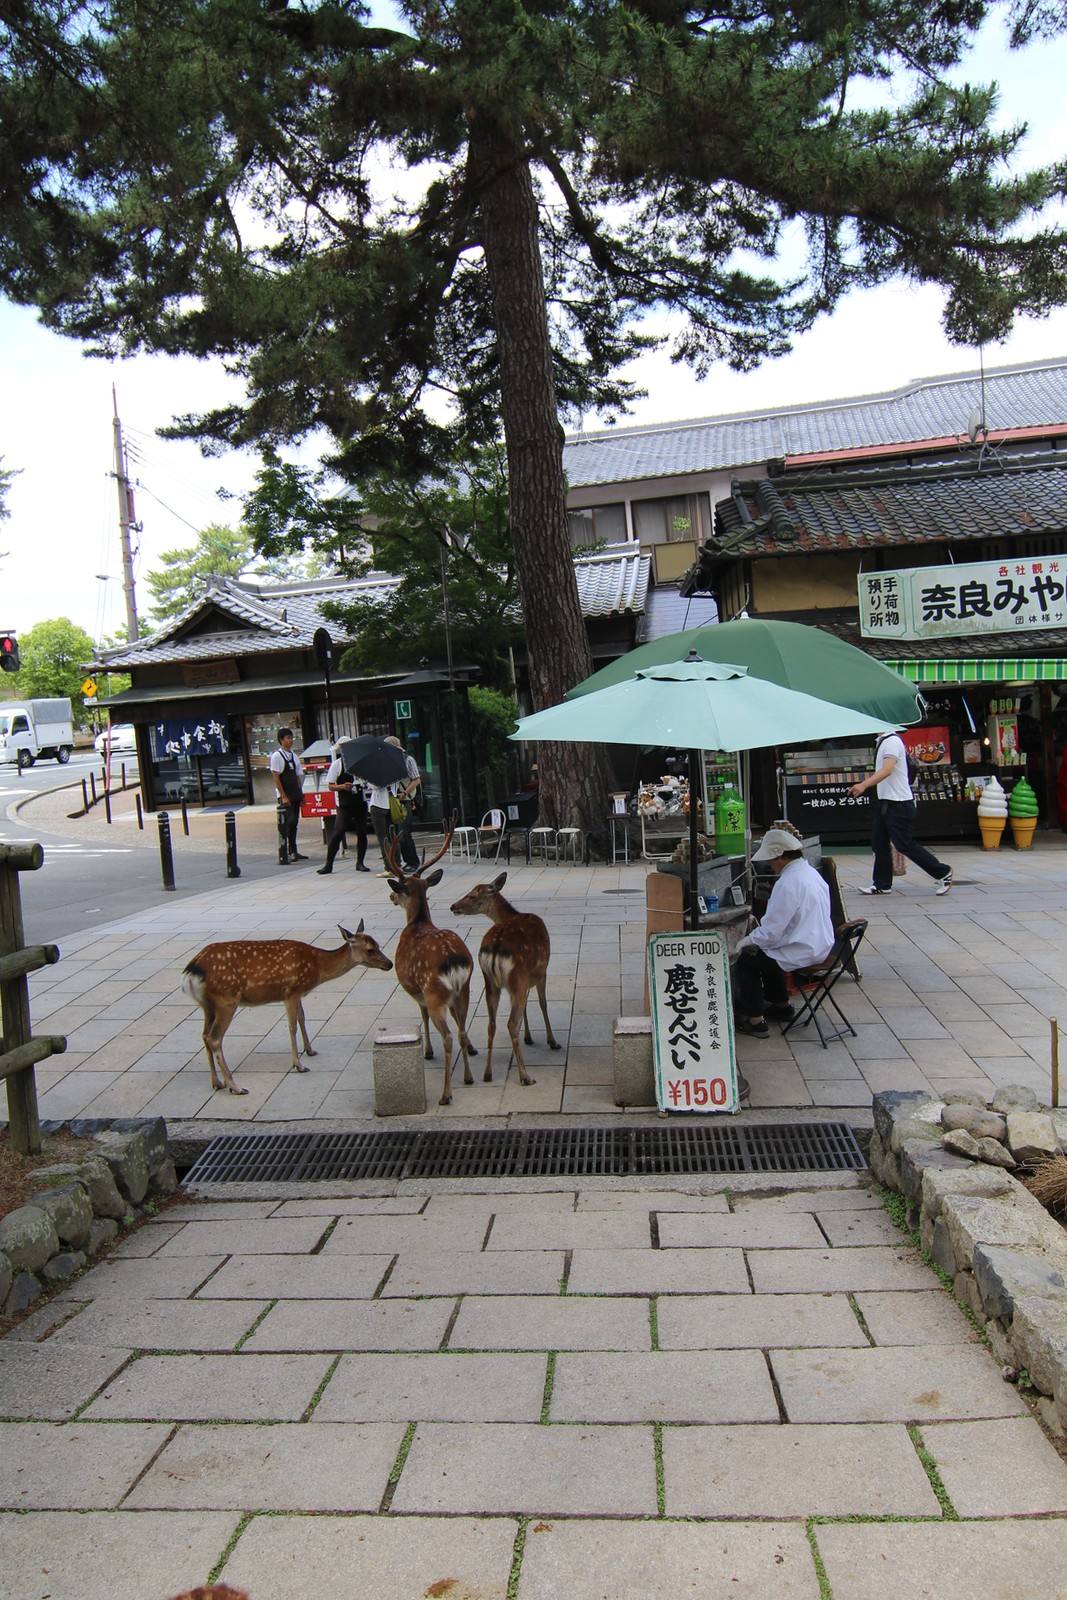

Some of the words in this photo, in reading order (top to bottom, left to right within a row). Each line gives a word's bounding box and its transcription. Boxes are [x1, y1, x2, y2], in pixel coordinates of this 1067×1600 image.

[867, 579, 884, 628] 預り所
[883, 576, 900, 626] 手荷物
[921, 575, 1067, 622] 奈良みや
[656, 943, 686, 957] DEER
[690, 941, 721, 956] FOOD
[664, 963, 702, 1070] 鹿せんべい
[704, 962, 722, 1050] 奈良県鹿愛護会
[668, 1077, 727, 1106] ¥150
